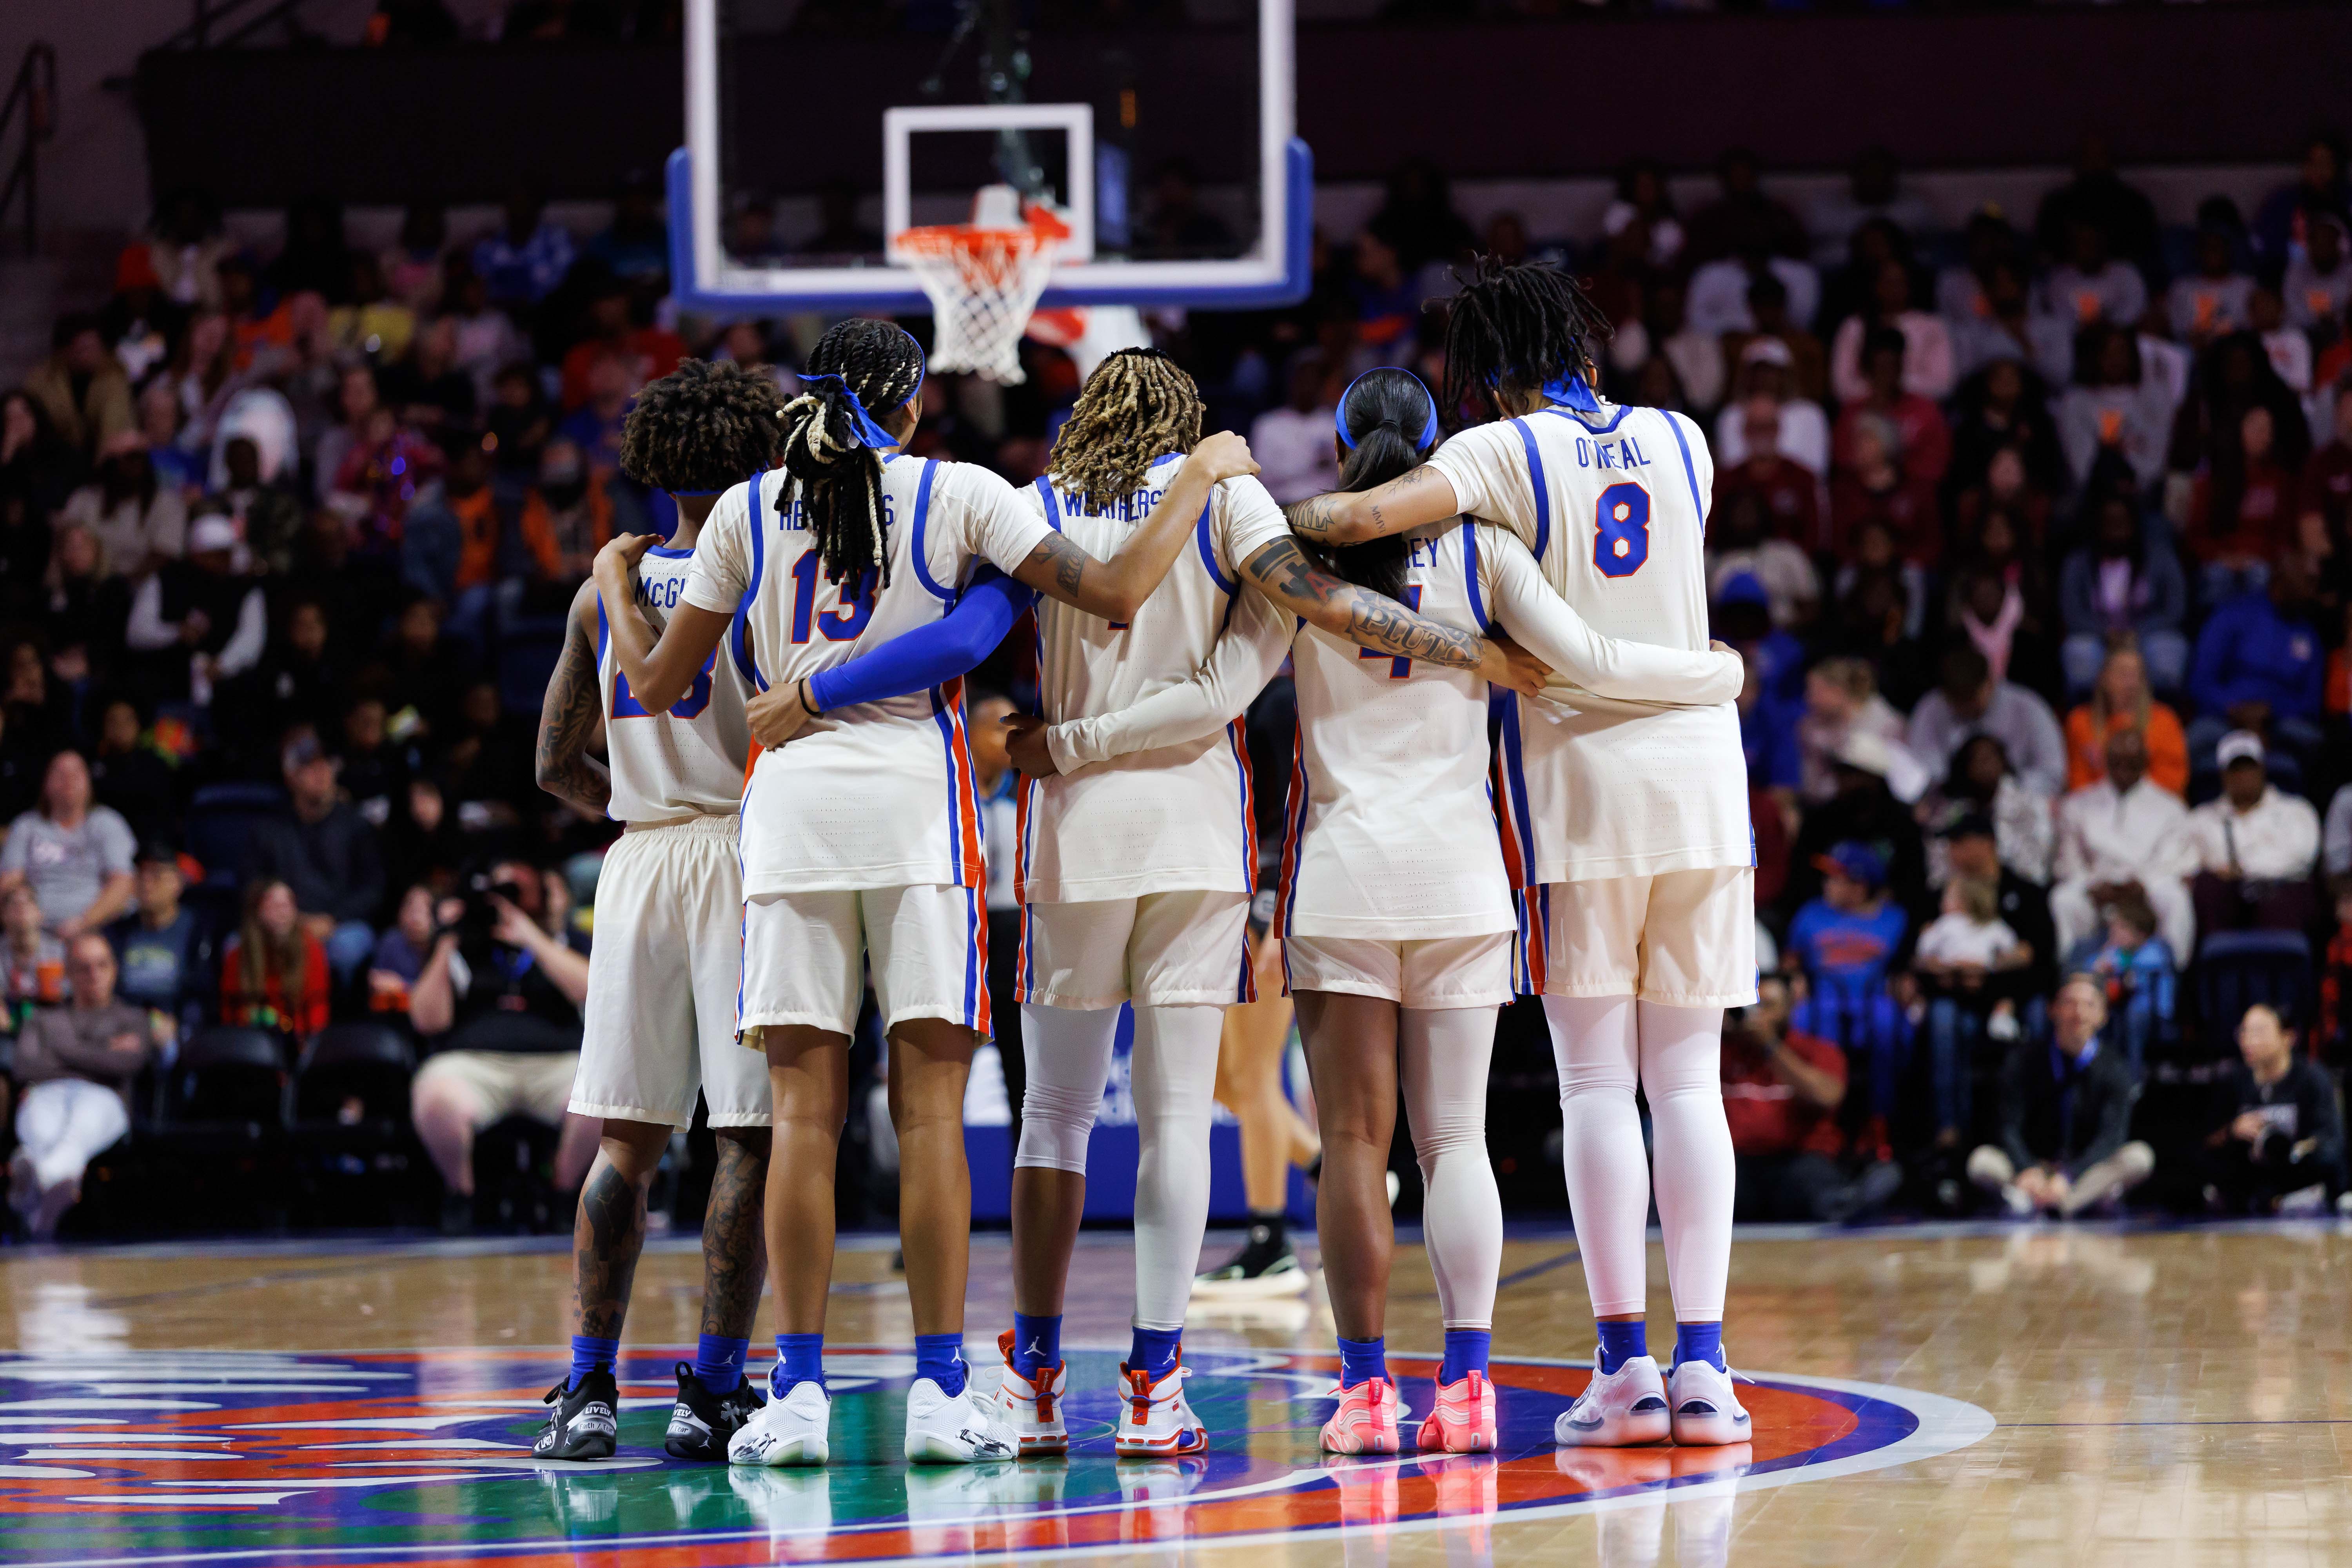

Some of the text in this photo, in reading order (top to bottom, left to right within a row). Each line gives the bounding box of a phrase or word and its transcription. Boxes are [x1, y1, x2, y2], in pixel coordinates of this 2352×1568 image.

[1576, 437, 1651, 470] O'NEAL
[1063, 490, 1167, 522] WEATHERS
[1593, 481, 1650, 578] 8
[791, 549, 880, 644] 13
[585, 1406, 611, 1416] LIVELY
[672, 1409, 691, 1417] VELY
